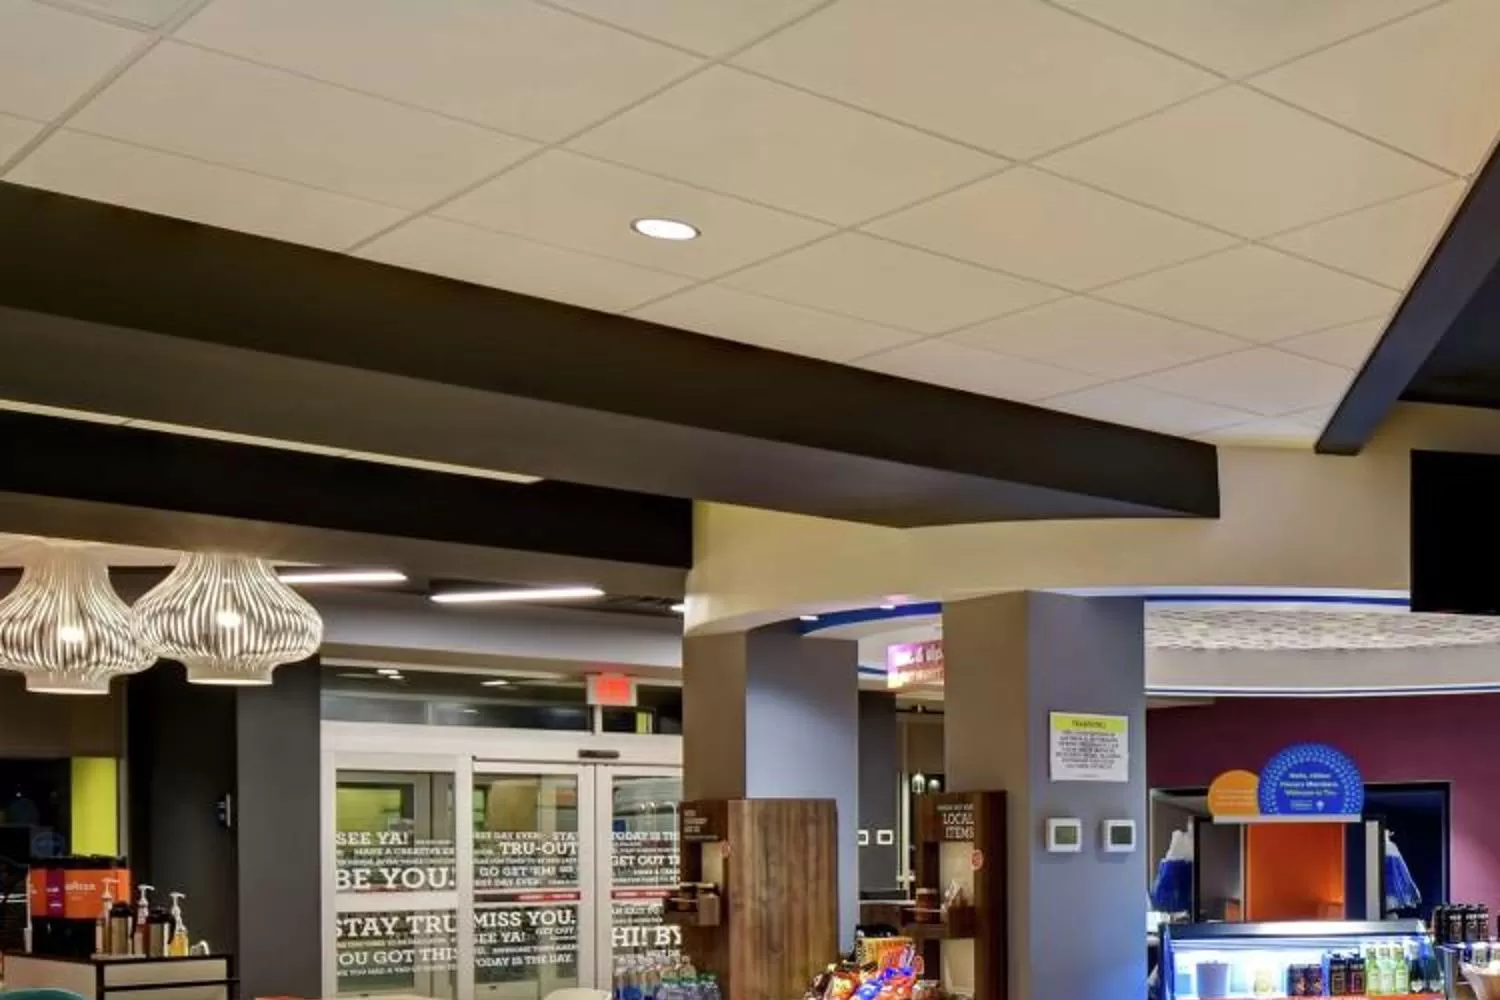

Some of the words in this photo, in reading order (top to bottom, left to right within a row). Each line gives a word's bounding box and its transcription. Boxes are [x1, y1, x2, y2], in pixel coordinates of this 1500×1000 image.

[943, 812, 975, 825] LOCAL
[336, 831, 371, 845] SEE
[376, 831, 409, 845] YA!
[637, 855, 664, 865] OUT
[336, 868, 371, 889] BE
[479, 866, 500, 877] GO
[611, 926, 648, 946] HI!
[336, 951, 368, 966] OU
[373, 949, 414, 965] GOT
